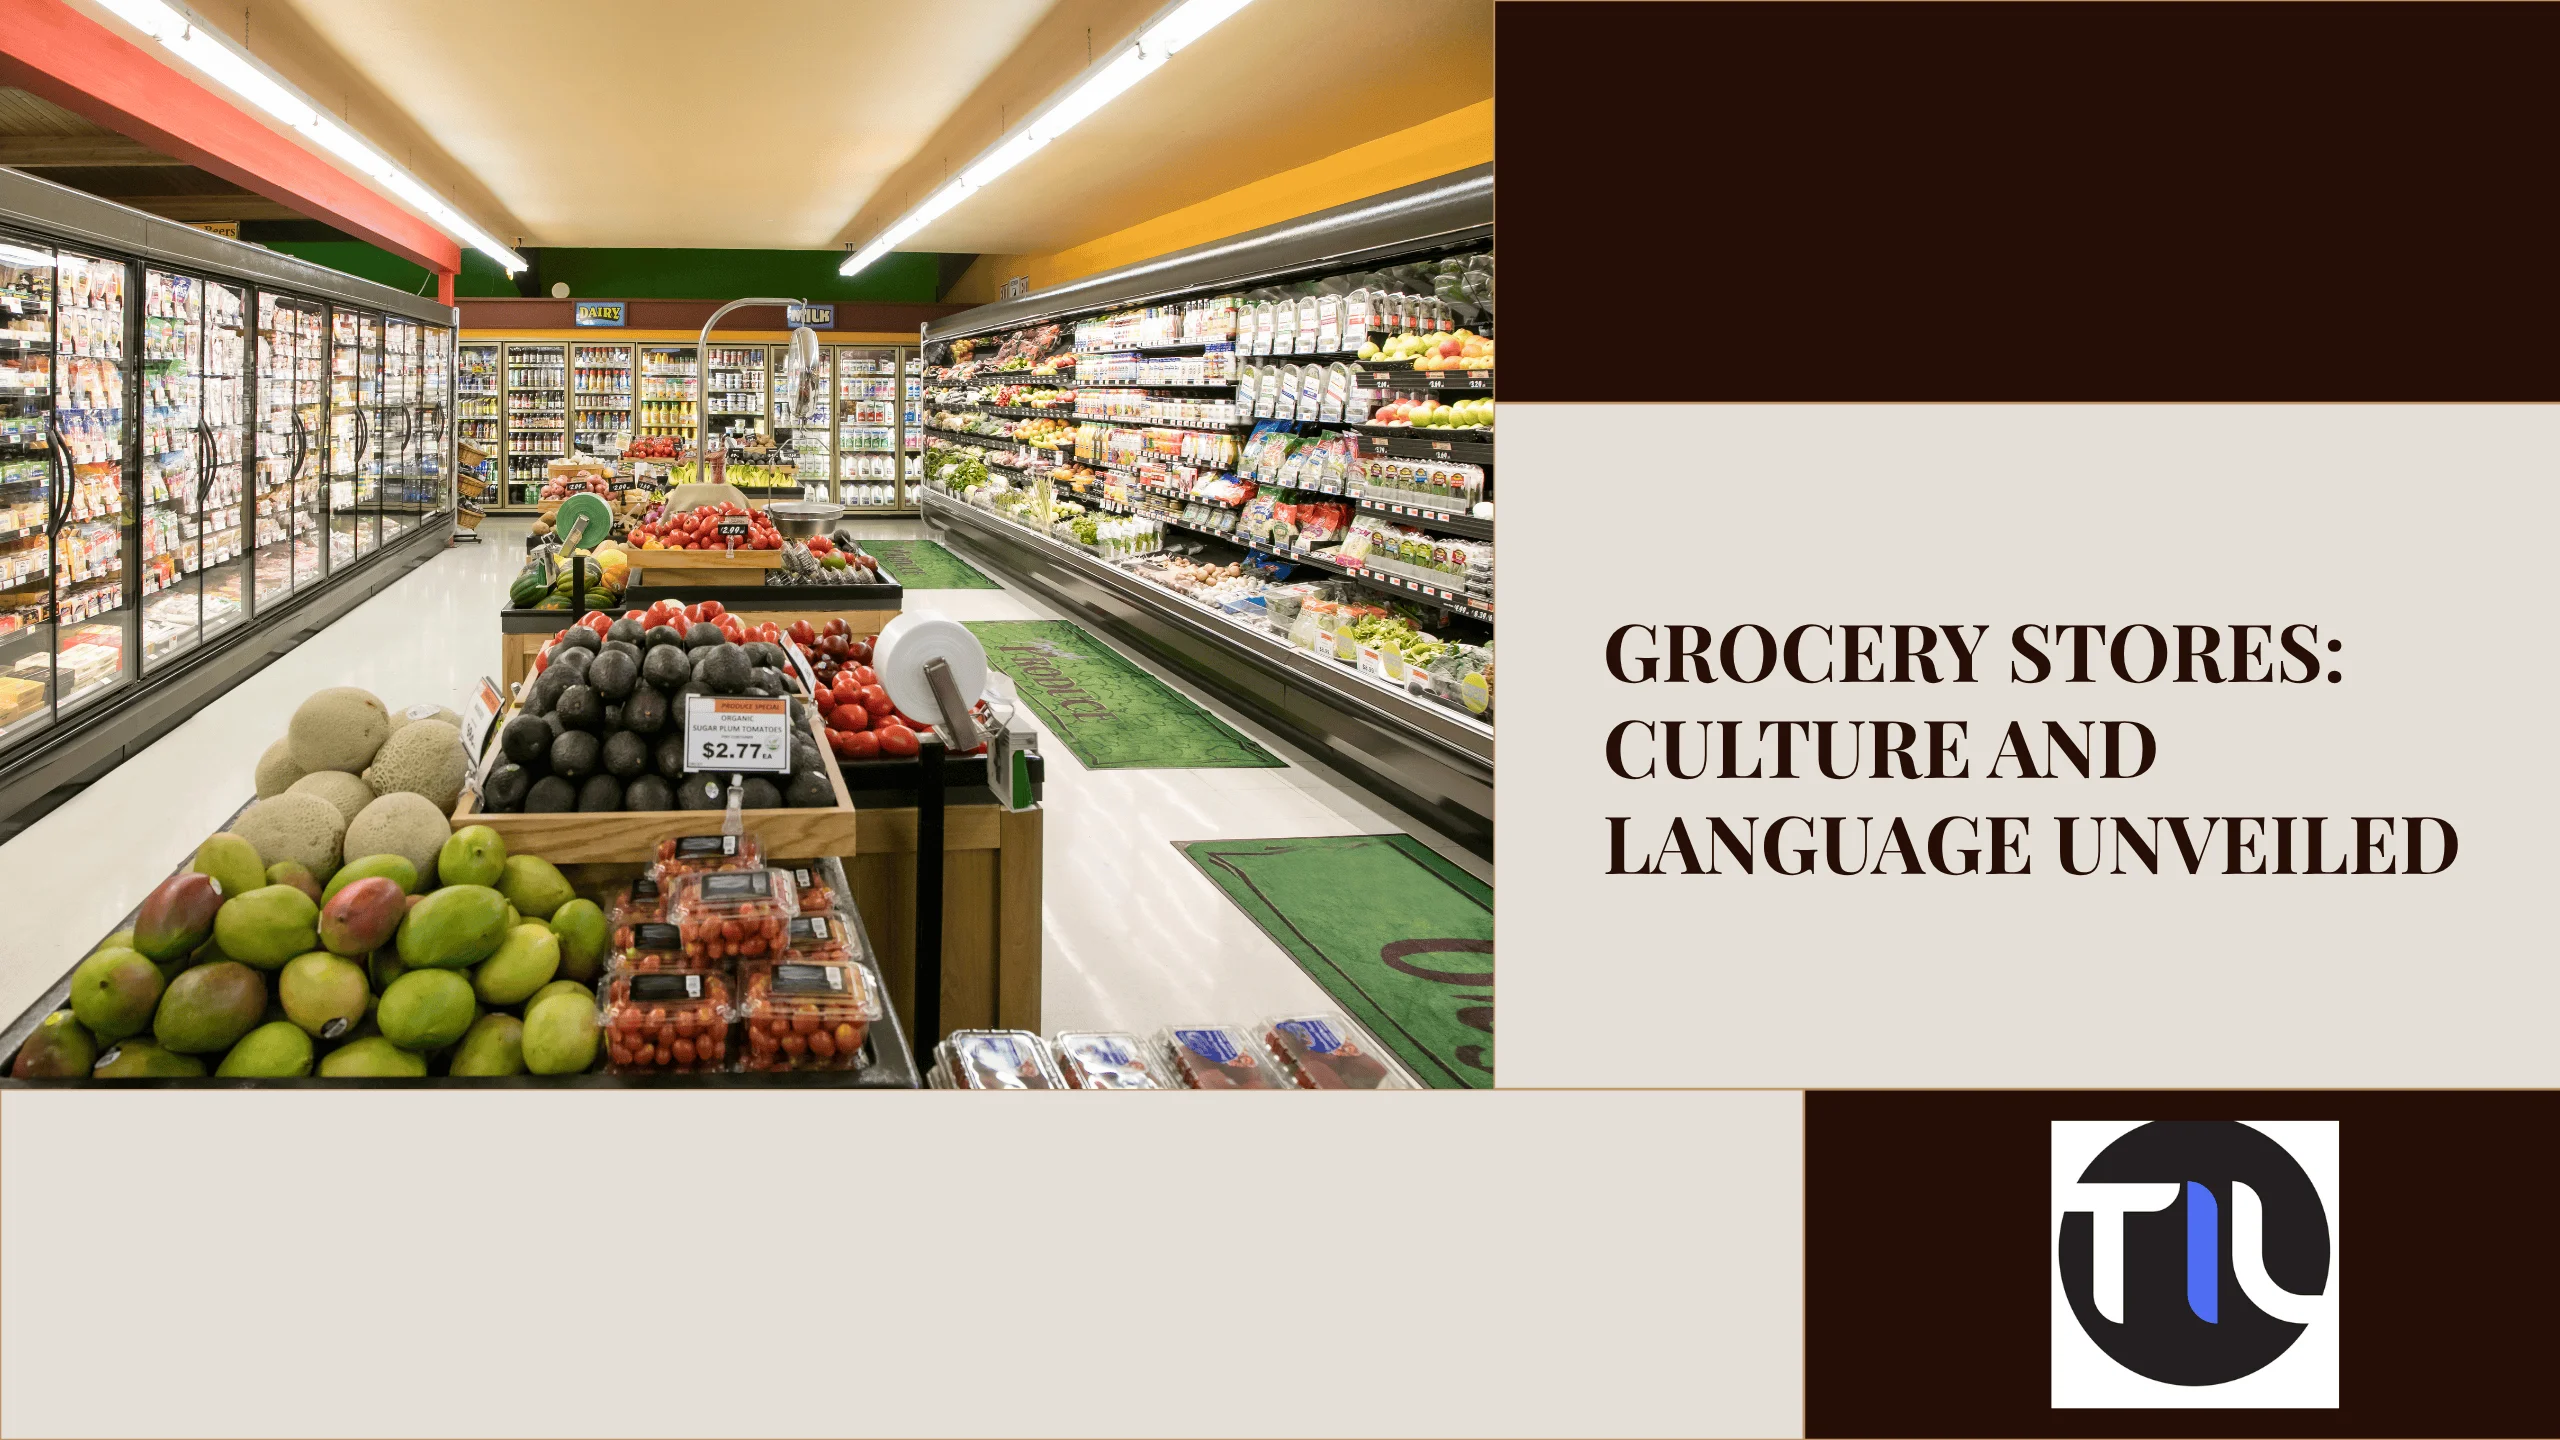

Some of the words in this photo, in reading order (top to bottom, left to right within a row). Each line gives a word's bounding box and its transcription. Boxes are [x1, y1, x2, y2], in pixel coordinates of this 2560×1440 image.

[579, 306, 621, 320] DAIRY
[791, 308, 830, 323] MILK
[1000, 646, 1121, 723] PRODUCE
[702, 741, 762, 760] $2.77
